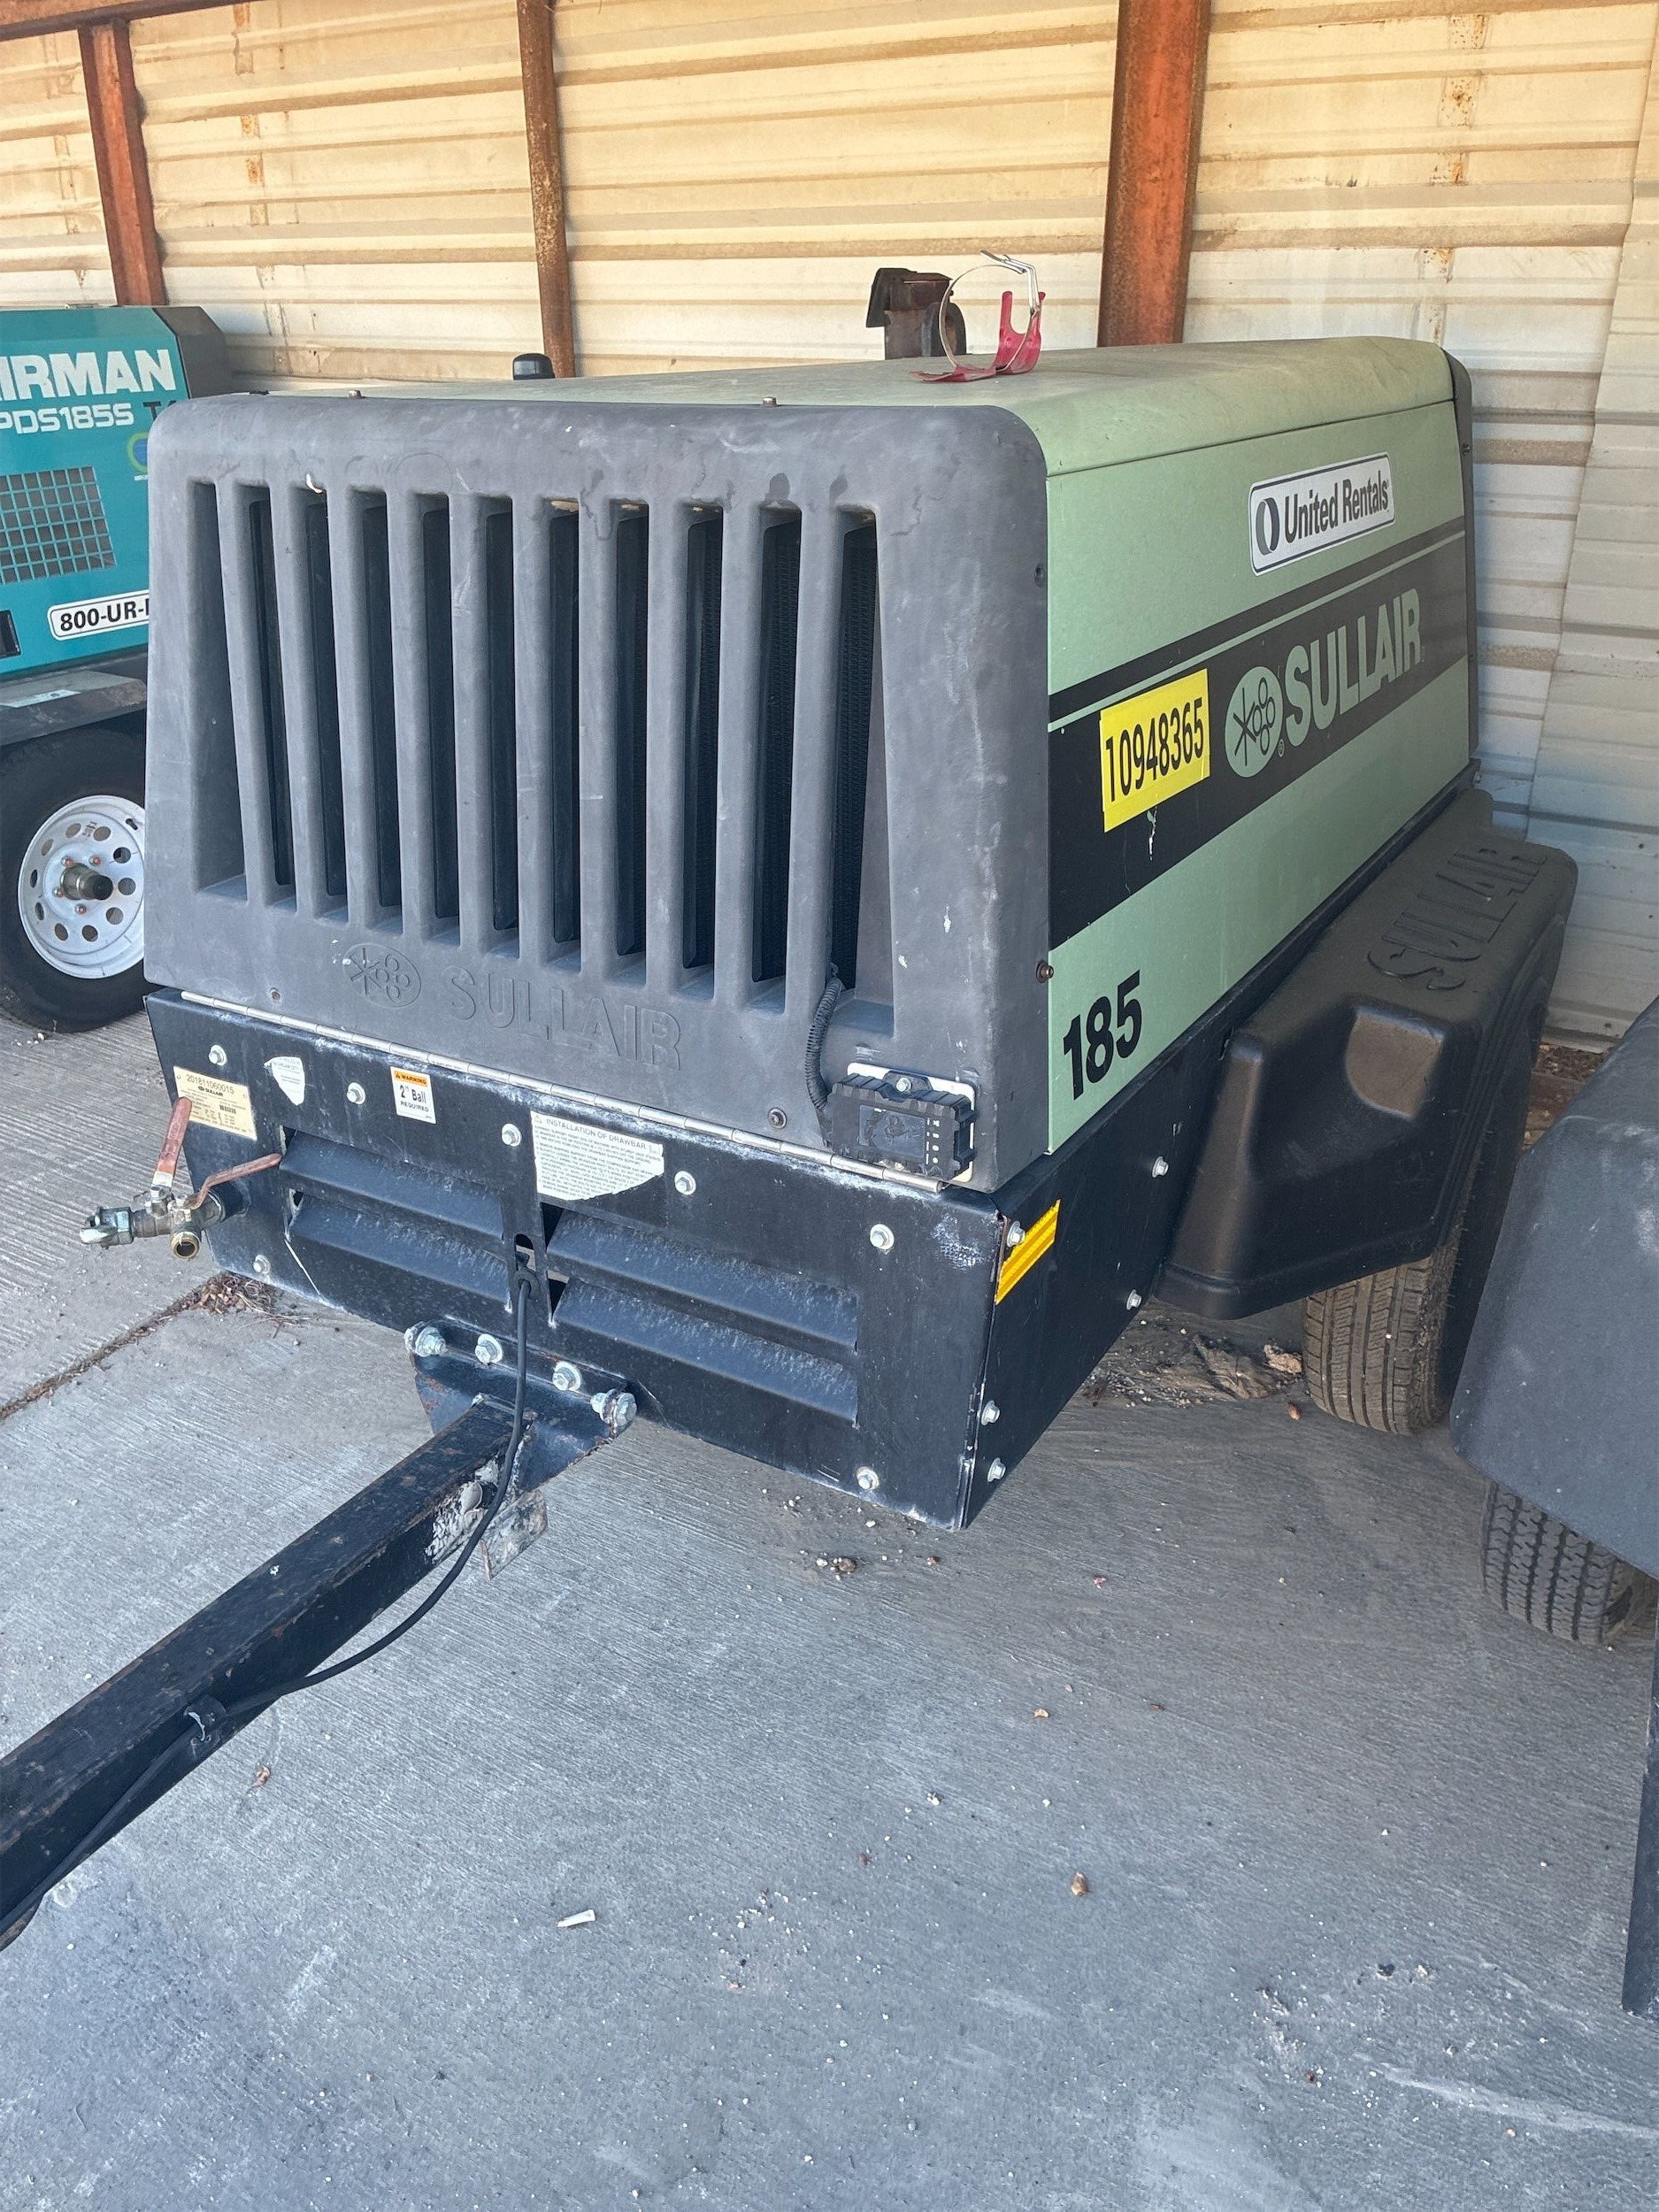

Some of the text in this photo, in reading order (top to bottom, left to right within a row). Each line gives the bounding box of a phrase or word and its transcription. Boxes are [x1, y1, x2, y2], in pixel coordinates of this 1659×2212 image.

[0, 349, 176, 401] IRMAN
[143, 400, 176, 421] T
[1285, 471, 1388, 543] United Rentals
[60, 598, 150, 632] 800-UR-
[1285, 588, 1421, 747] SULLAIR
[1106, 697, 1203, 802] 10948365
[1366, 848, 1548, 991] SULLAIR
[442, 965, 680, 1071] SULLAIR
[1064, 970, 1141, 1101] 185
[402, 1073, 426, 1085] WARNING
[411, 1088, 426, 1103] Ball
[401, 1101, 429, 1112] REQUIRED
[546, 1118, 646, 1149] INSTALLATION OF DRAWBAR
